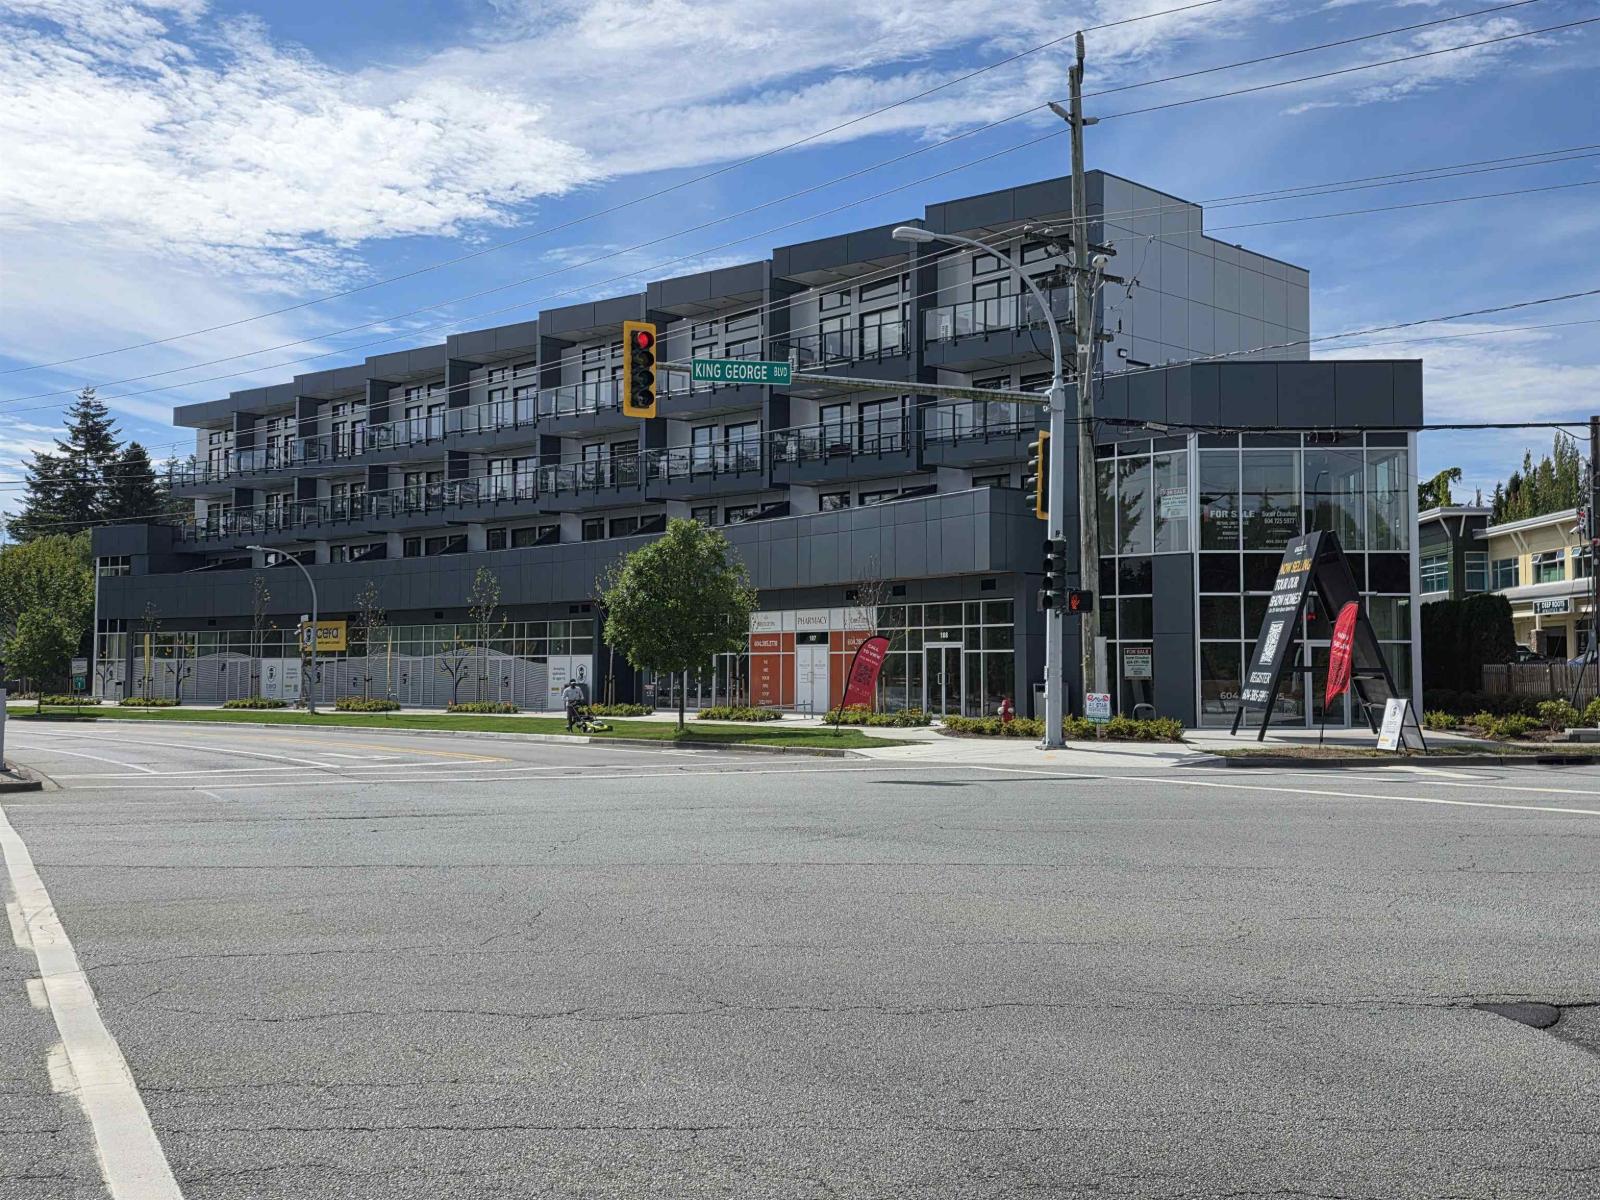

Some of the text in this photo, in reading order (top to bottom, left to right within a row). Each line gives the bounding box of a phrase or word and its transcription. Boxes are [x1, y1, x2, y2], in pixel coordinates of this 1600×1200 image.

[695, 363, 788, 380] KING GEORGE BLVD
[1209, 510, 1229, 518] FOR
[1230, 510, 1256, 518] SLE
[1279, 558, 1312, 575] NOW SELLING
[1274, 576, 1300, 591] TOUR OUR
[1541, 600, 1565, 609] DEEP ROOTS
[797, 616, 827, 625] PHARMACY
[867, 643, 879, 652] CALL
[869, 650, 882, 659] VIEW
[1249, 671, 1272, 684] REGISTER
[1220, 691, 1239, 700] 604
